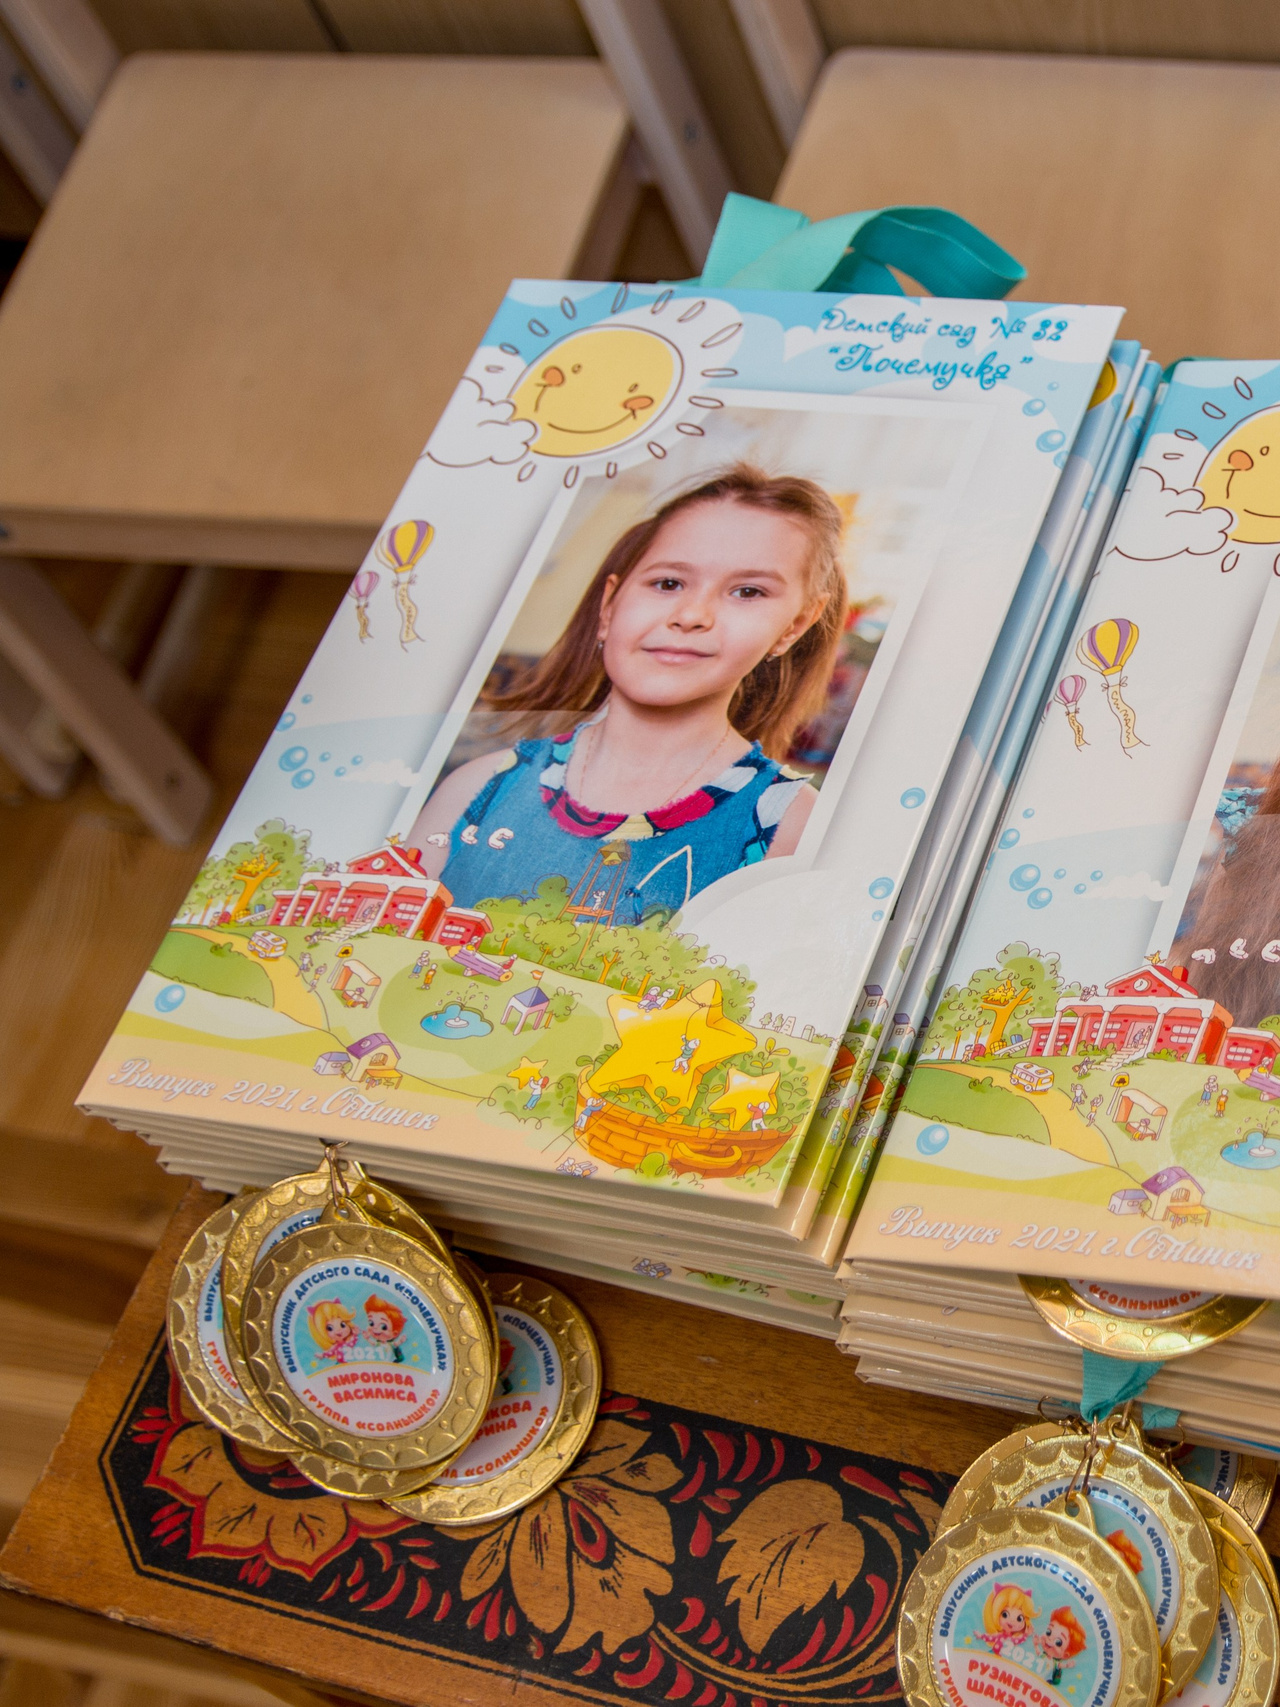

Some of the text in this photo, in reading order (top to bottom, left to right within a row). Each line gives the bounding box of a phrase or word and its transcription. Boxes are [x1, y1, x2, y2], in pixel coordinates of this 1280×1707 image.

[821, 308, 931, 343] Детский
[937, 324, 977, 348] сад
[1032, 319, 1068, 342] 32
[108, 1057, 217, 1101] Выпуск
[879, 1205, 1001, 1251] Выпуск
[1088, 1283, 1201, 1311] «СОЛНЫШКО»
[280, 1265, 448, 1374] ВЫПУСКНИК ДЕТСКОГО САДА «ПОЧЕМУЧКА»
[343, 1346, 387, 1361] 2021
[502, 1313, 555, 1386] «ПОЧЕМУЧКА»
[327, 1371, 415, 1389] МИРОНОВА
[333, 1387, 418, 1404] ВАСИЛИСА
[302, 1388, 441, 1432] ГРУППА «СОЛНЫШКО»
[464, 1405, 549, 1478] «СОЛНЫШКО»
[1146, 1526, 1172, 1633] «ПОЧЕМУЧКА
[939, 1555, 1114, 1707] ВЫПУСКНИК ДЕТСКОГО САДА «ПОЧЕМУЧКА
[1000, 1639, 1045, 1674] 2021
[939, 1659, 968, 1707] ГРУПП
